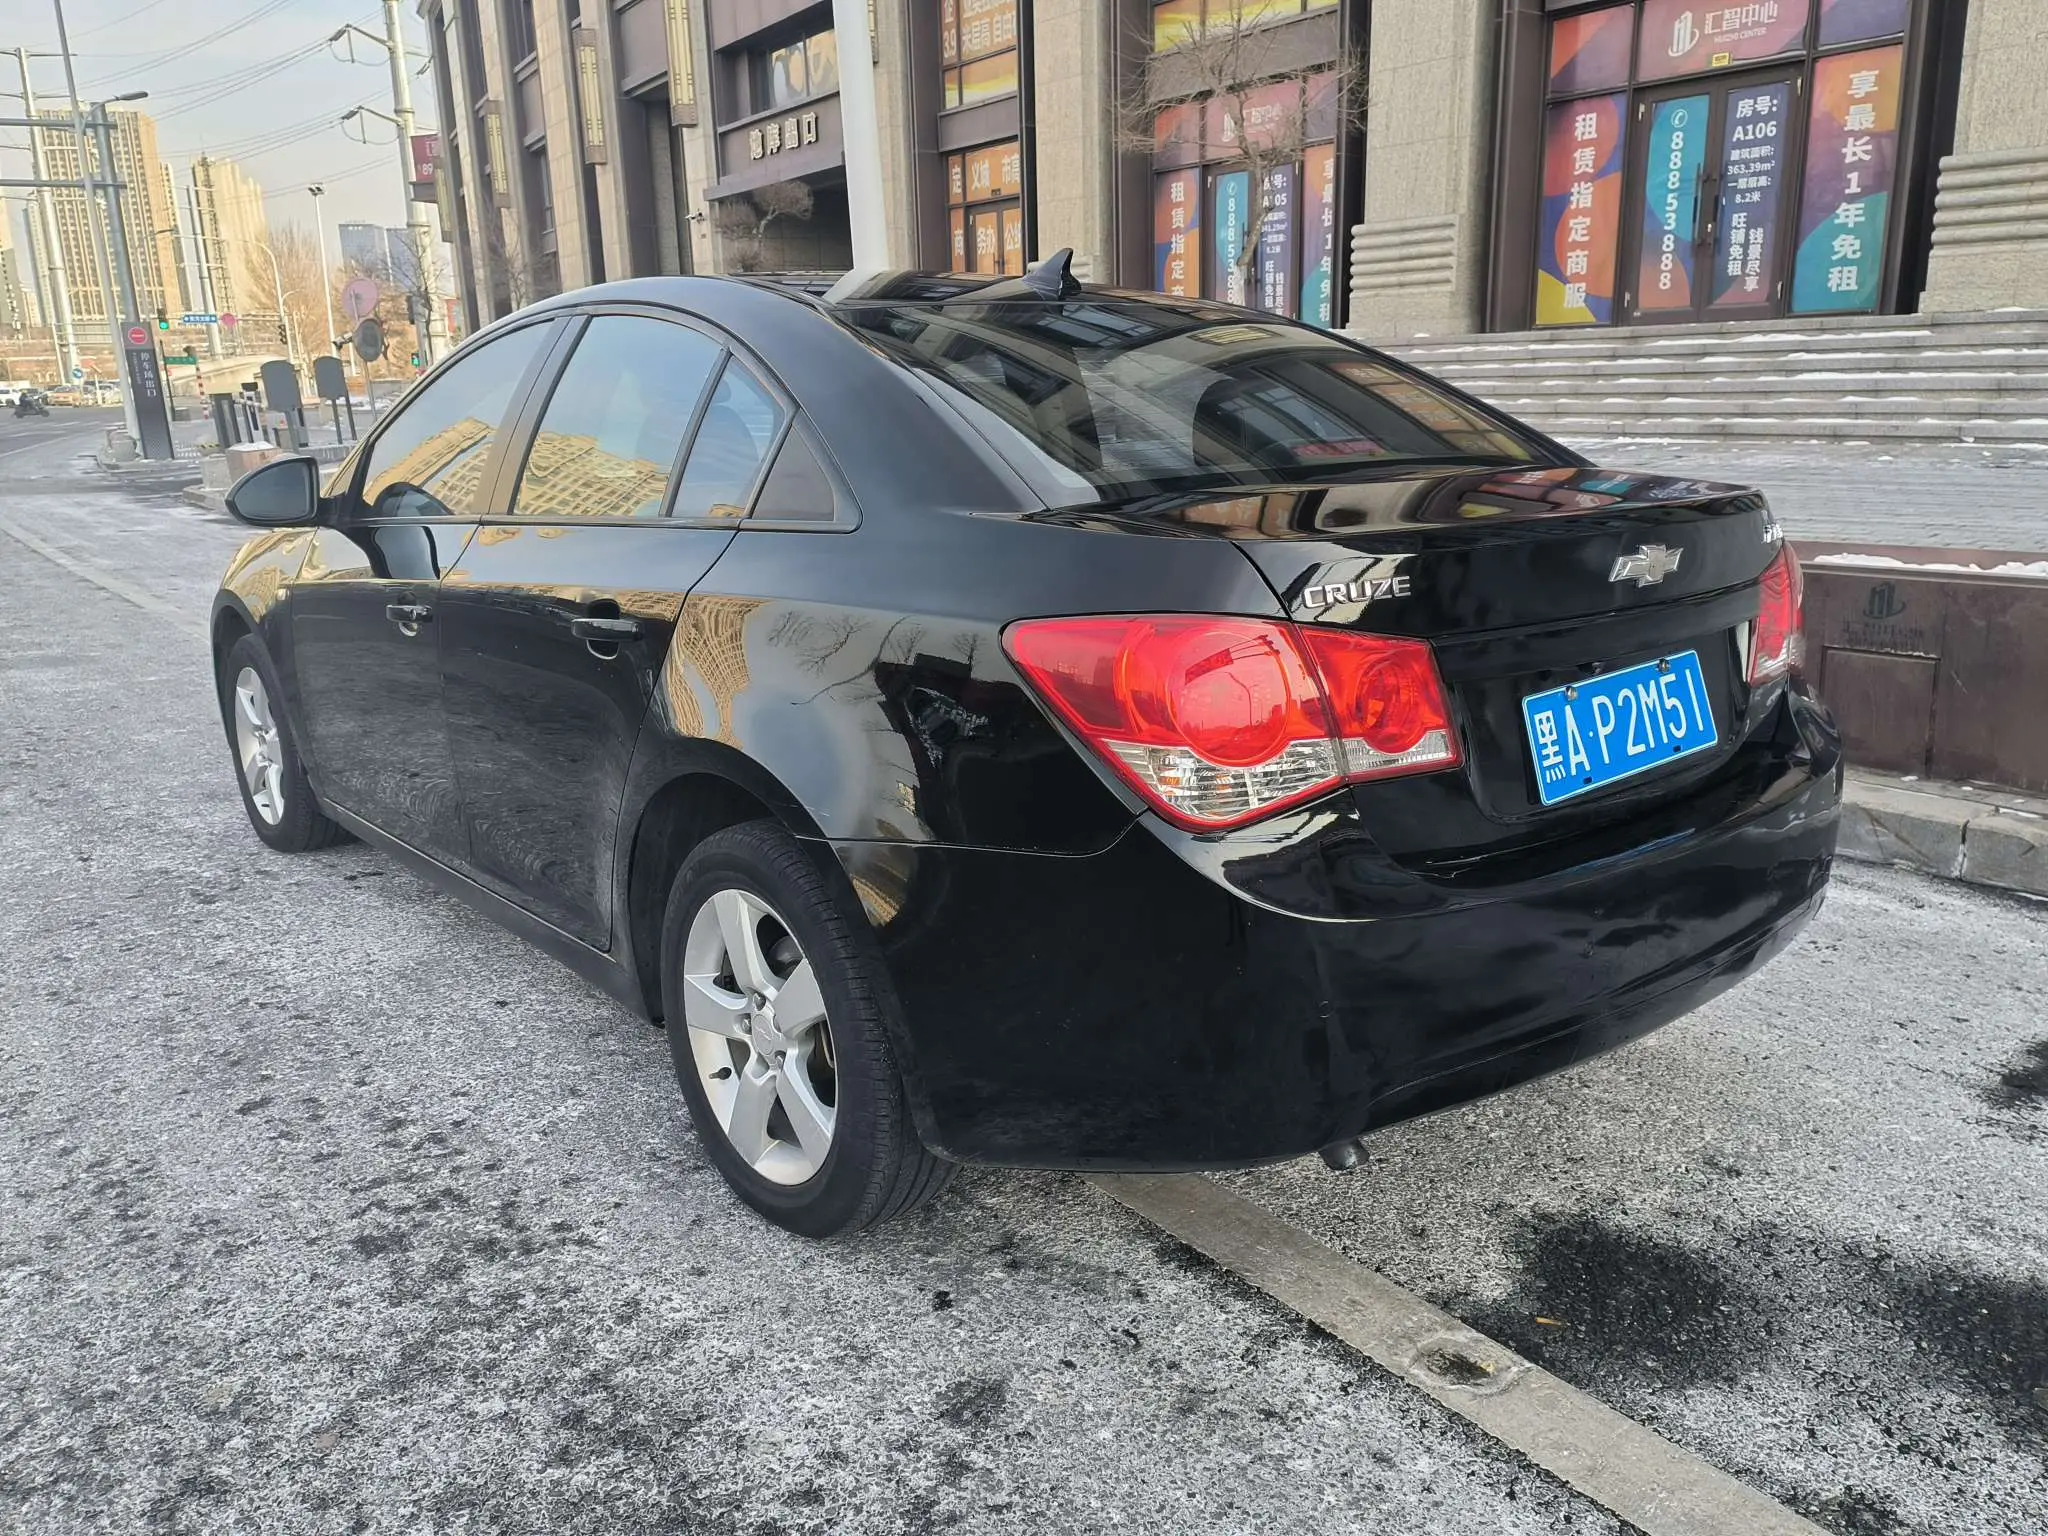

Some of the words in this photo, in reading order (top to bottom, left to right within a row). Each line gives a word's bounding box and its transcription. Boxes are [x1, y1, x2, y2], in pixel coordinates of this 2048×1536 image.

[1704, 1, 1778, 34] 汇智中心
[1740, 27, 1767, 39] CENTER
[1732, 120, 1777, 142] A106
[1827, 70, 1880, 293] 享最长1年免租
[1262, 193, 1287, 208] A05
[1563, 112, 1598, 309] 租赁指定商服
[1659, 131, 1684, 290] 88853888
[1727, 212, 1748, 276] 旺铺免租
[1303, 575, 1412, 609] CRUZE
